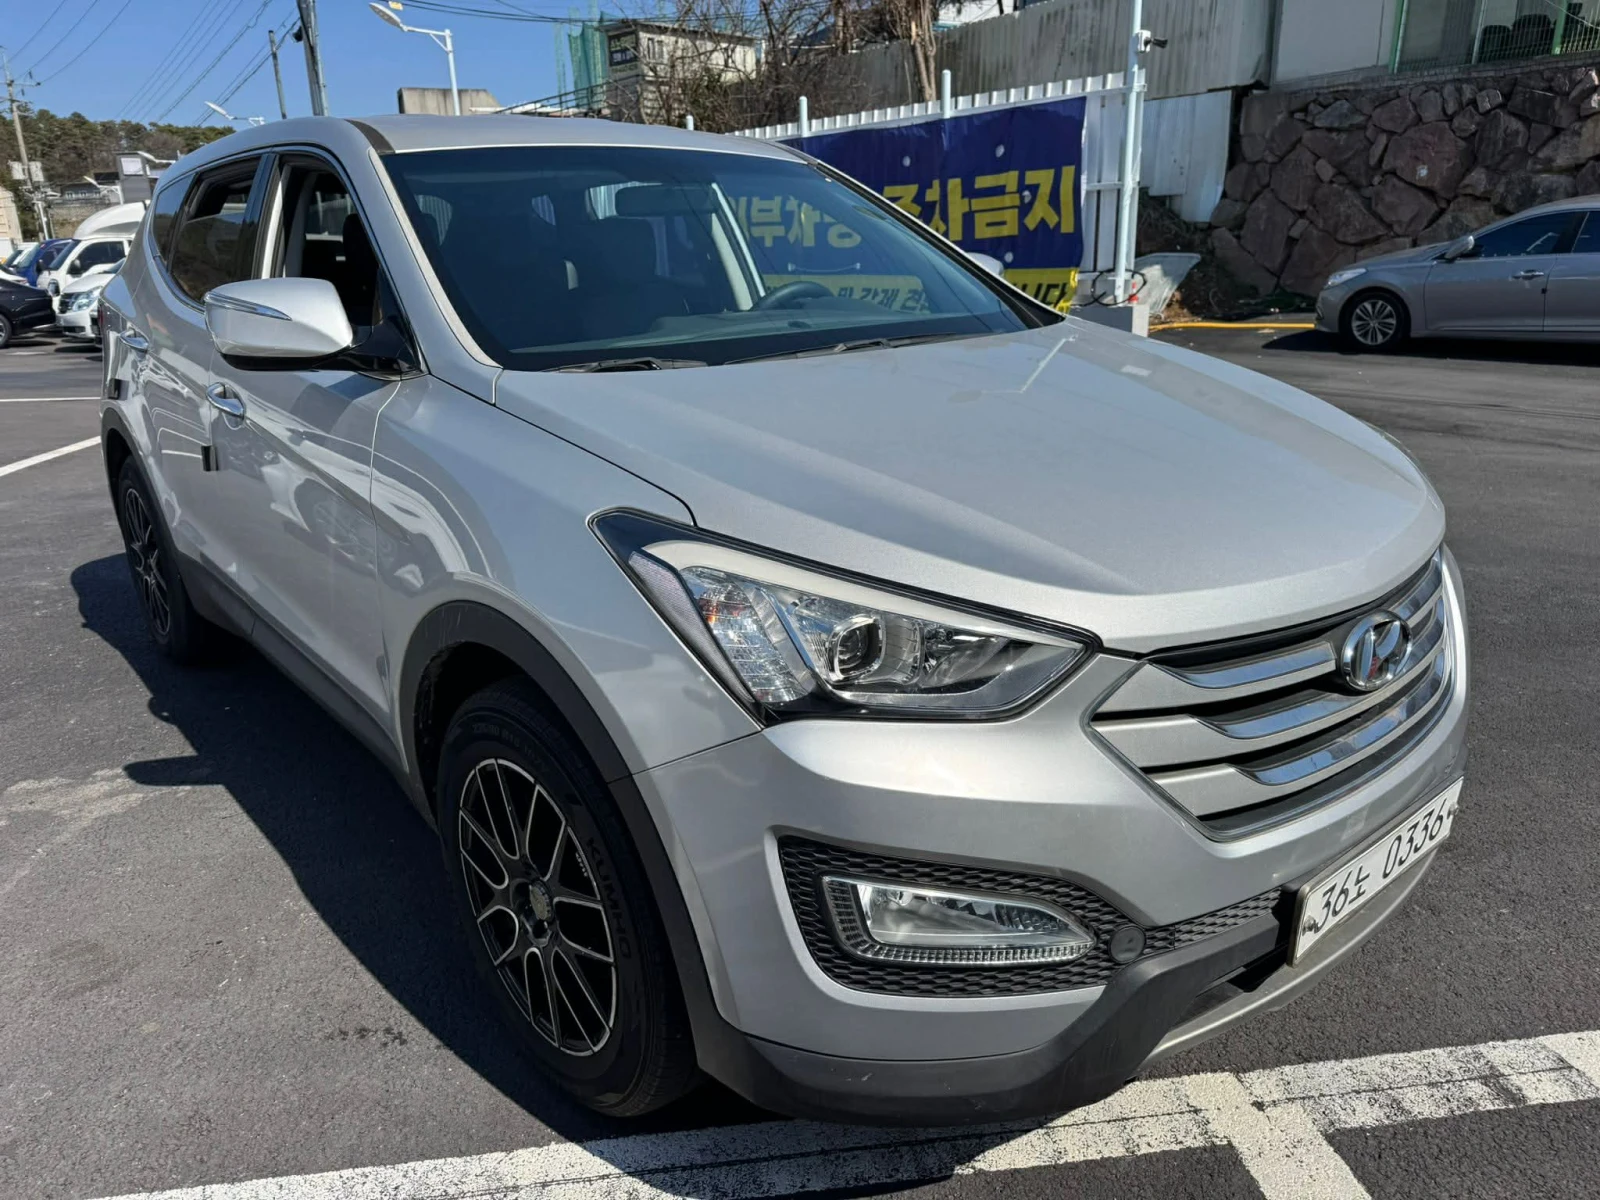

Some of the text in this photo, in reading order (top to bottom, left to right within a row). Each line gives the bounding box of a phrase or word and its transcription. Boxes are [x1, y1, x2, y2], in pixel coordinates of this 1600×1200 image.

[587, 837, 632, 958] KUMHO
[1314, 797, 1448, 934] 36노 0336
